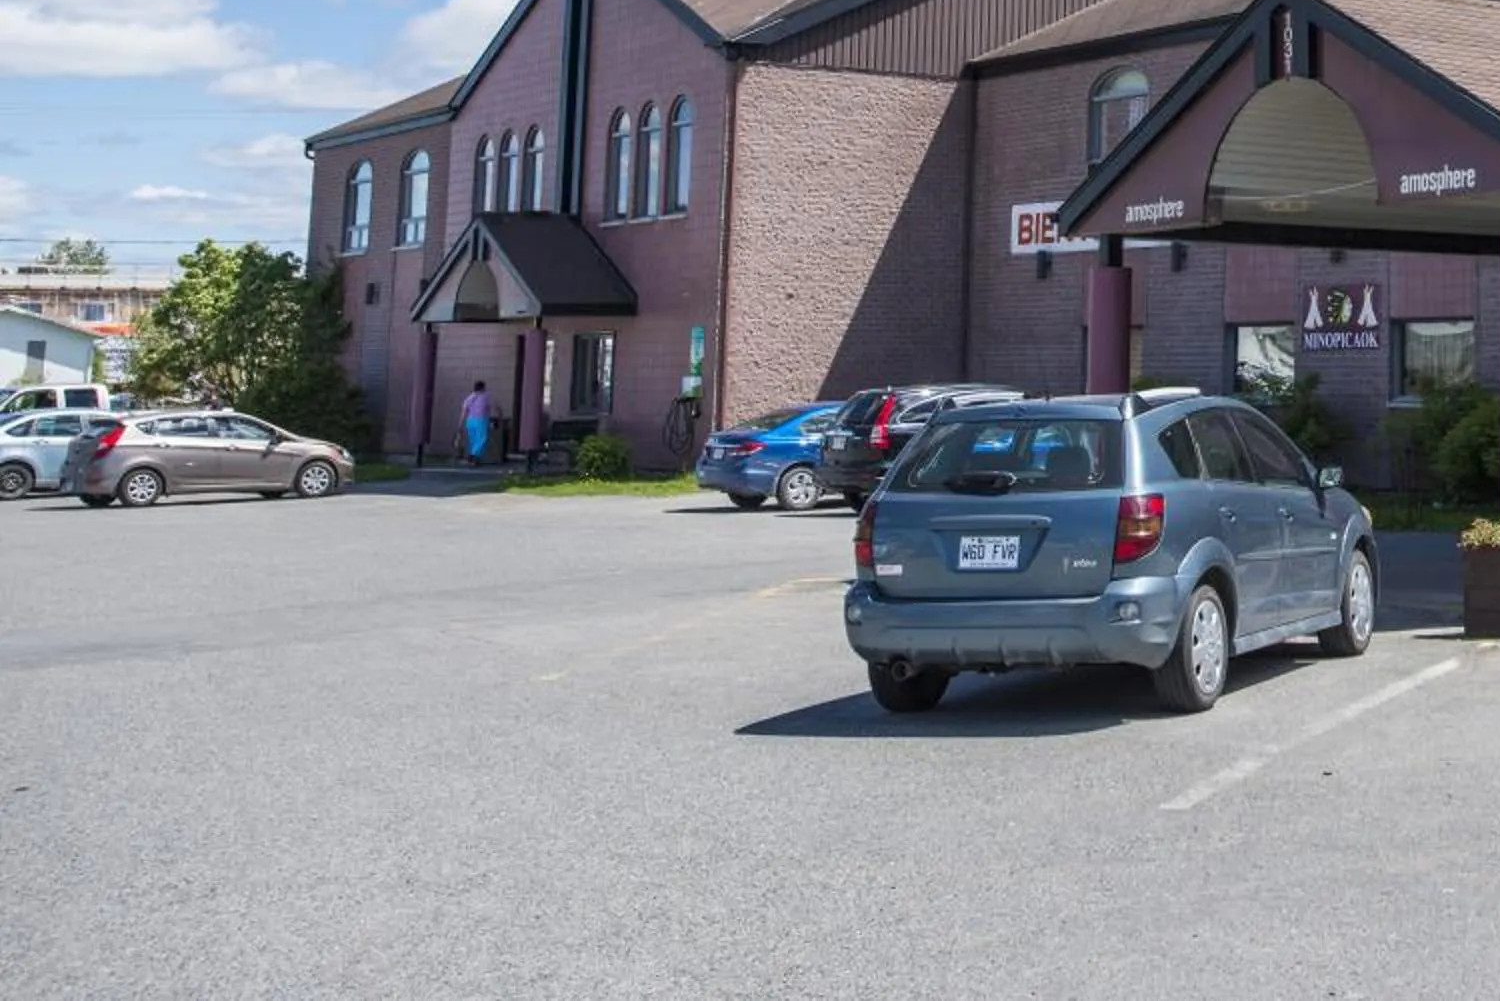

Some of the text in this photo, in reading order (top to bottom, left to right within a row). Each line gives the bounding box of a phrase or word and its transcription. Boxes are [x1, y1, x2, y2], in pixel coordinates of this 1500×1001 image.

[1400, 164, 1476, 195] amosphere
[1125, 196, 1185, 224] amosphere
[993, 543, 1016, 560] FVR
